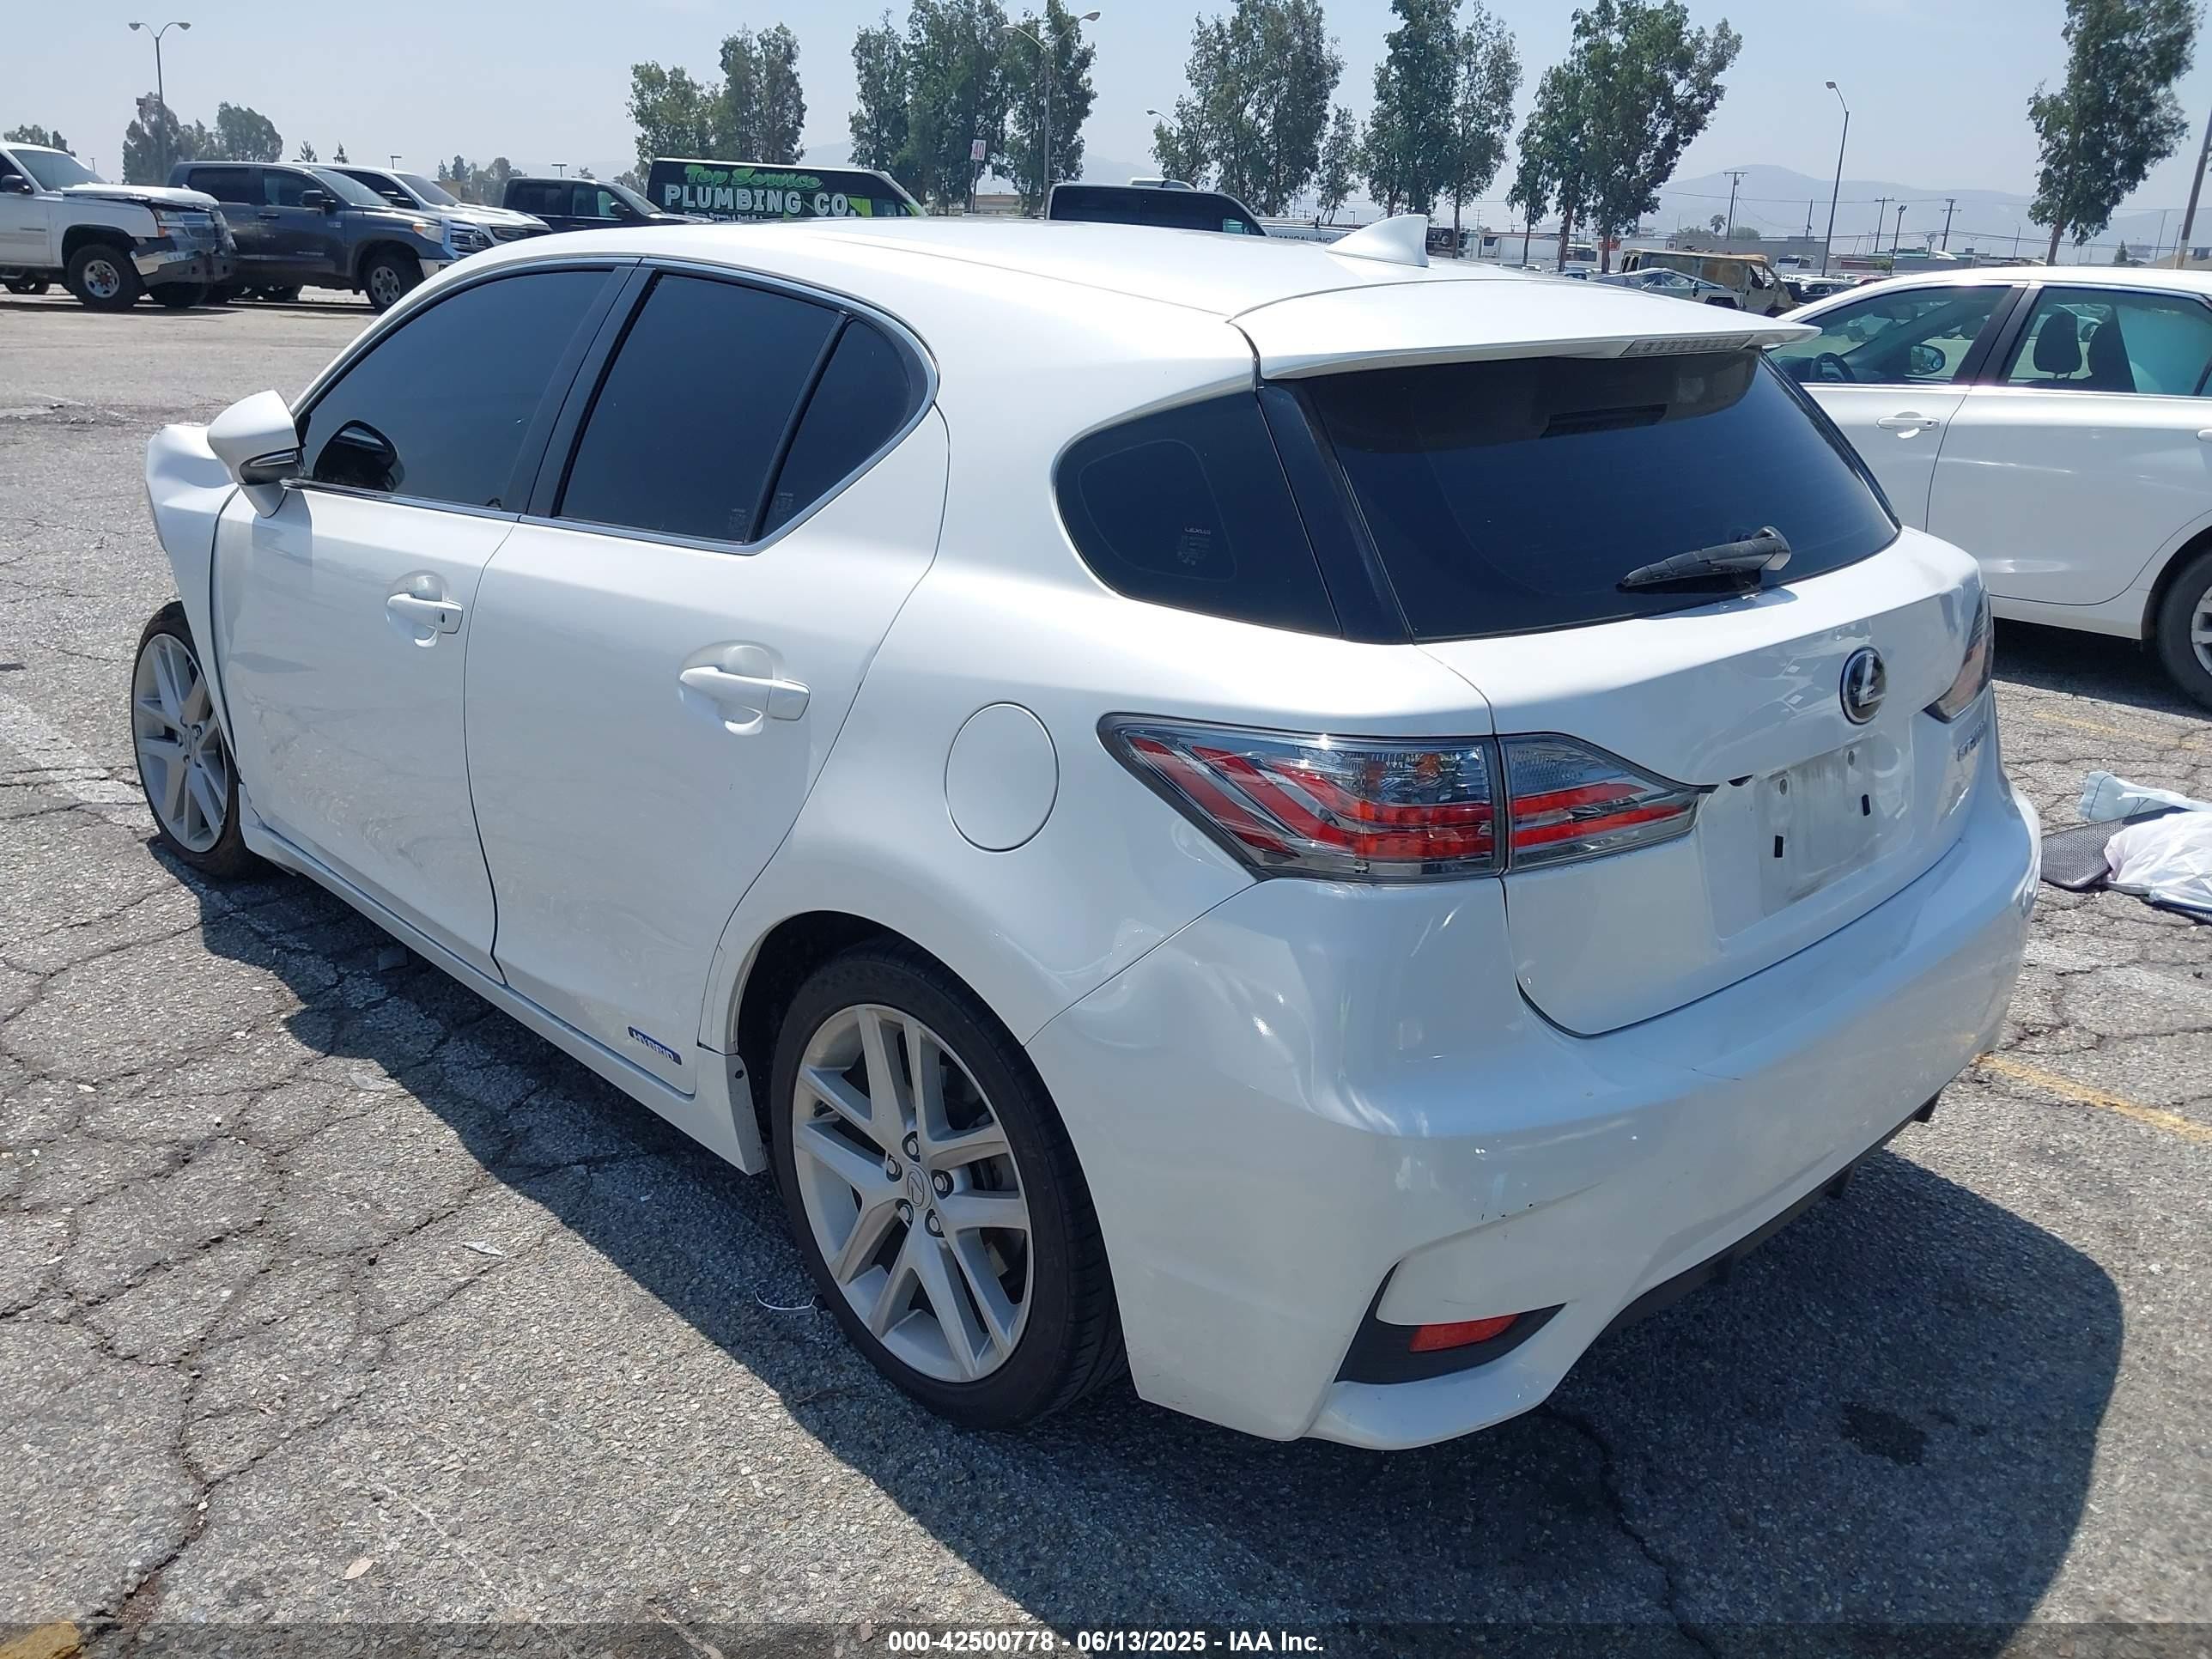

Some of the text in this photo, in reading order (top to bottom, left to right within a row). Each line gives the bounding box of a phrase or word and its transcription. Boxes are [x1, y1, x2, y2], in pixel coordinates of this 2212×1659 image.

[684, 165, 823, 189] Top Service
[665, 185, 857, 216] PLUMBING CO.
